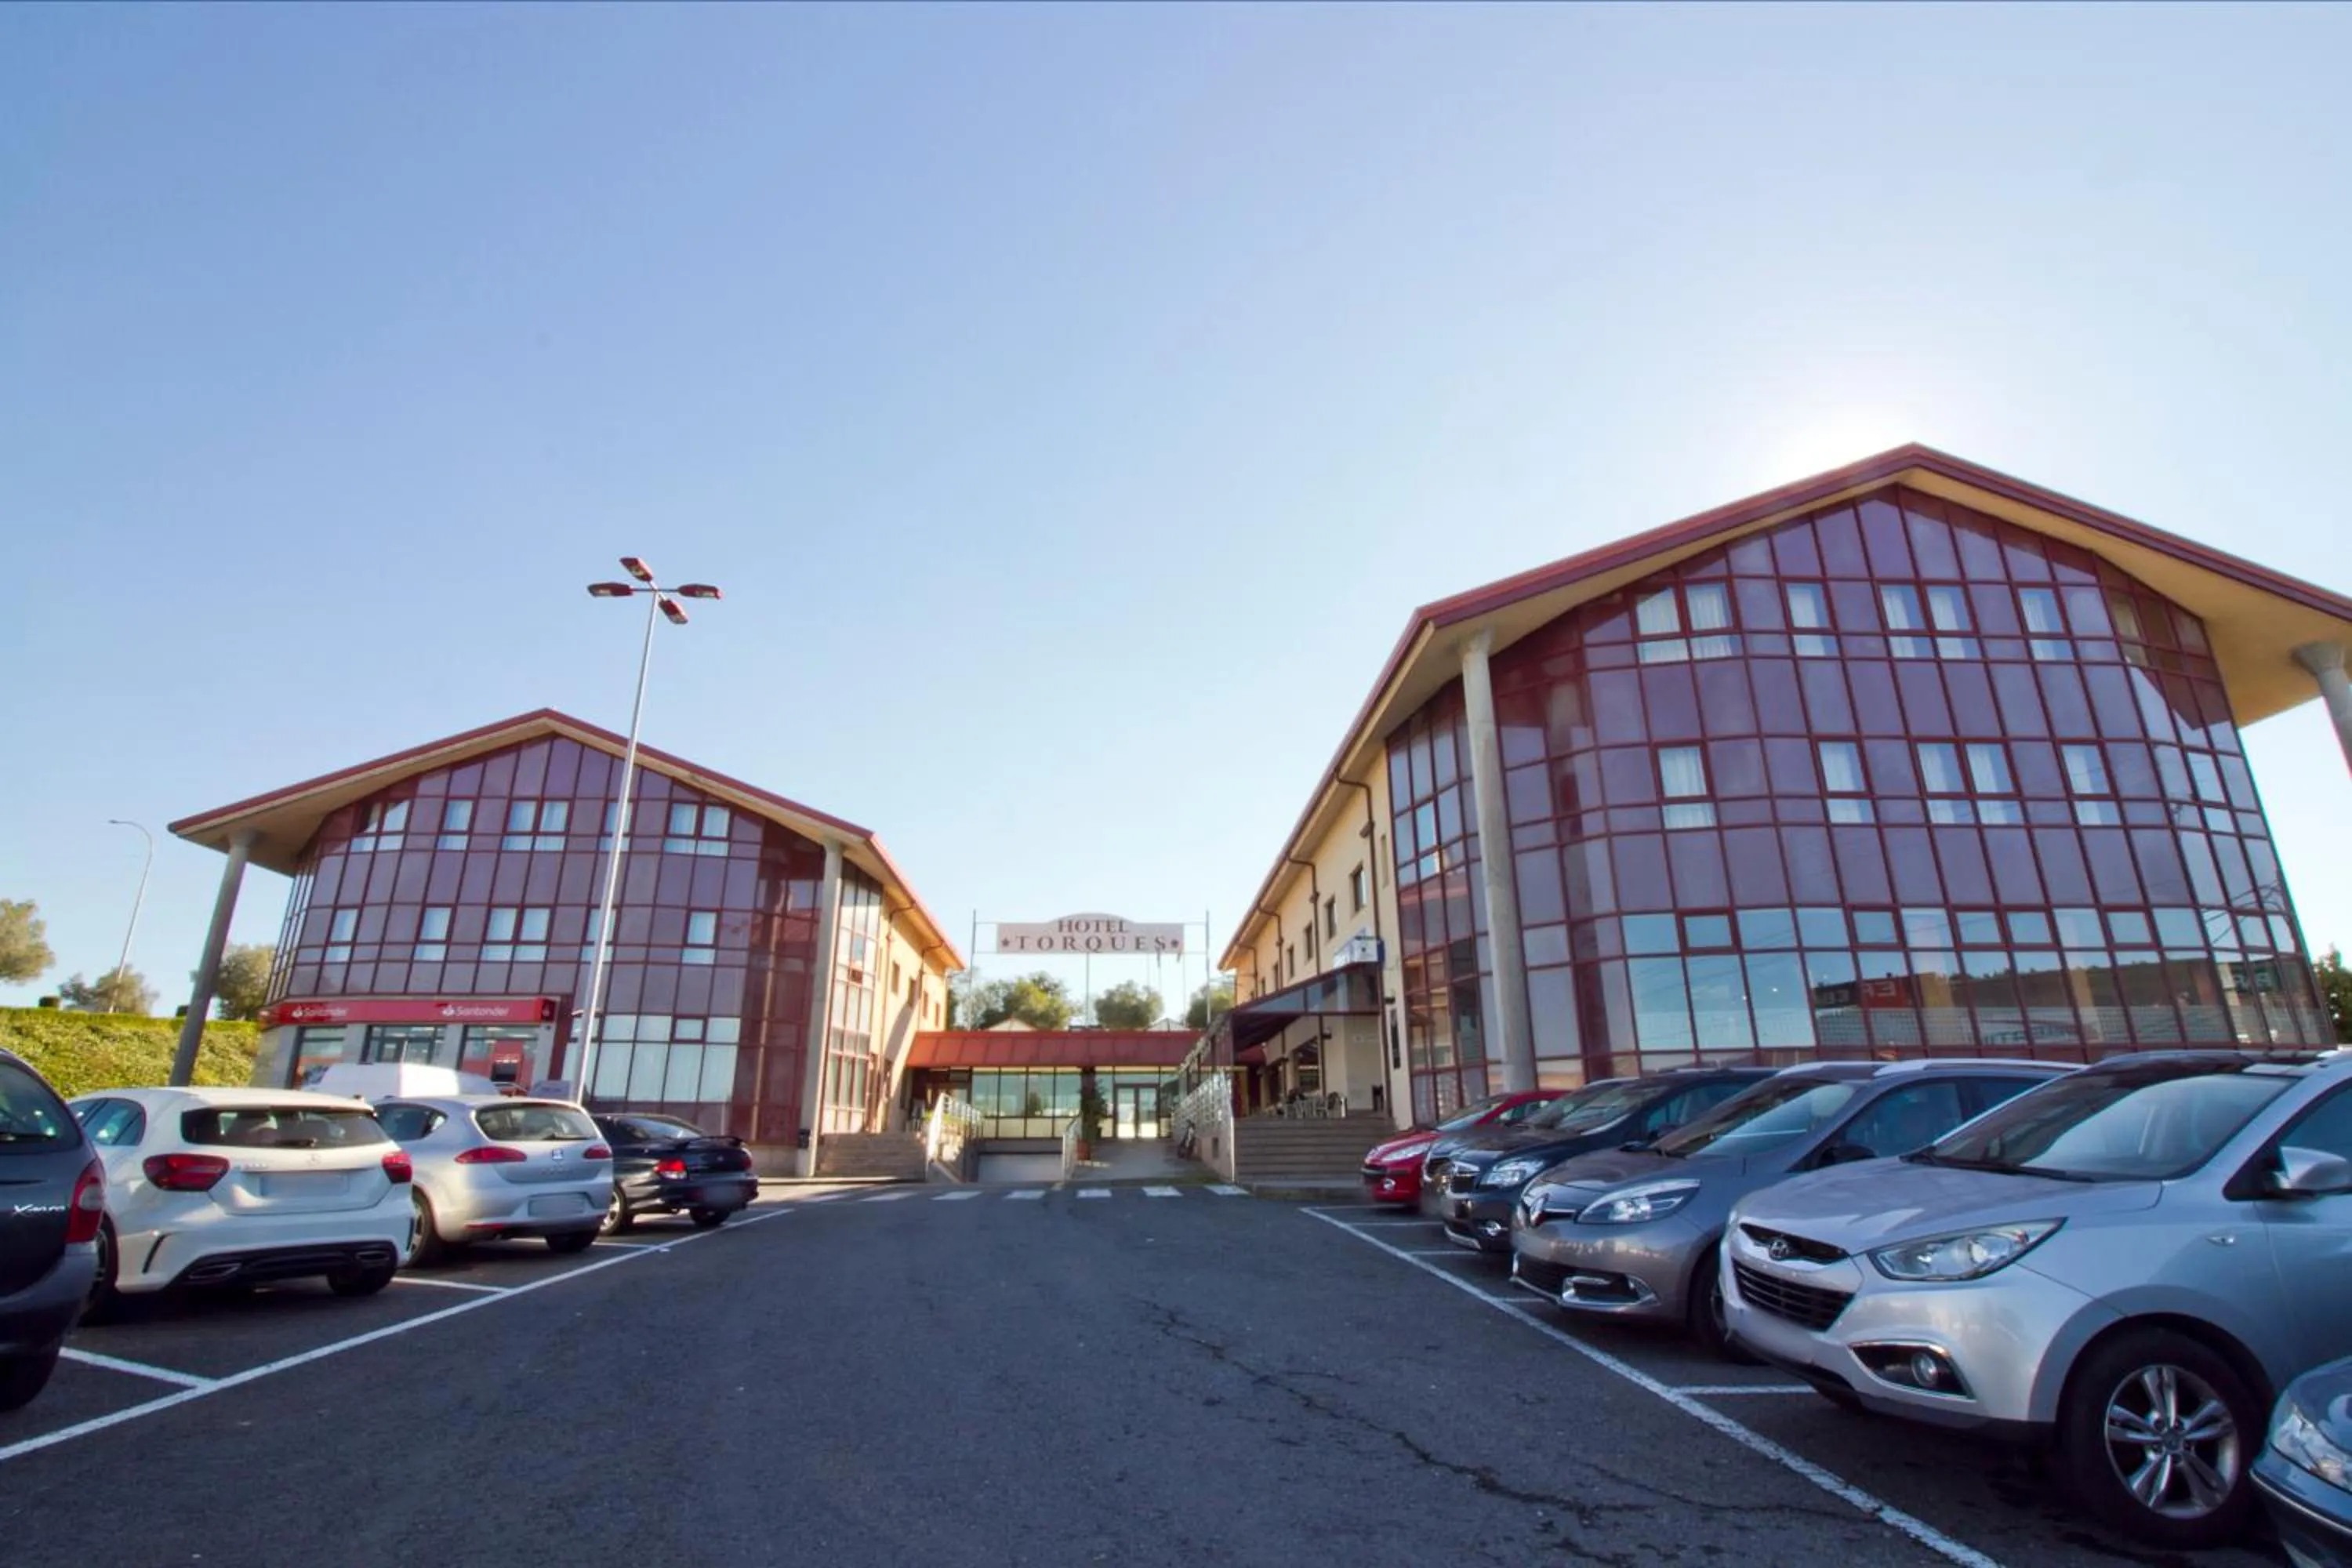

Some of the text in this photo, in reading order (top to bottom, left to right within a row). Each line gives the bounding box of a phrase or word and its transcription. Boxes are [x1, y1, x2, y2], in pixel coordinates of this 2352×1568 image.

[1058, 919, 1130, 934] HOTEL
[1015, 935, 1167, 953] TORQUES
[456, 1005, 510, 1017] Santander
